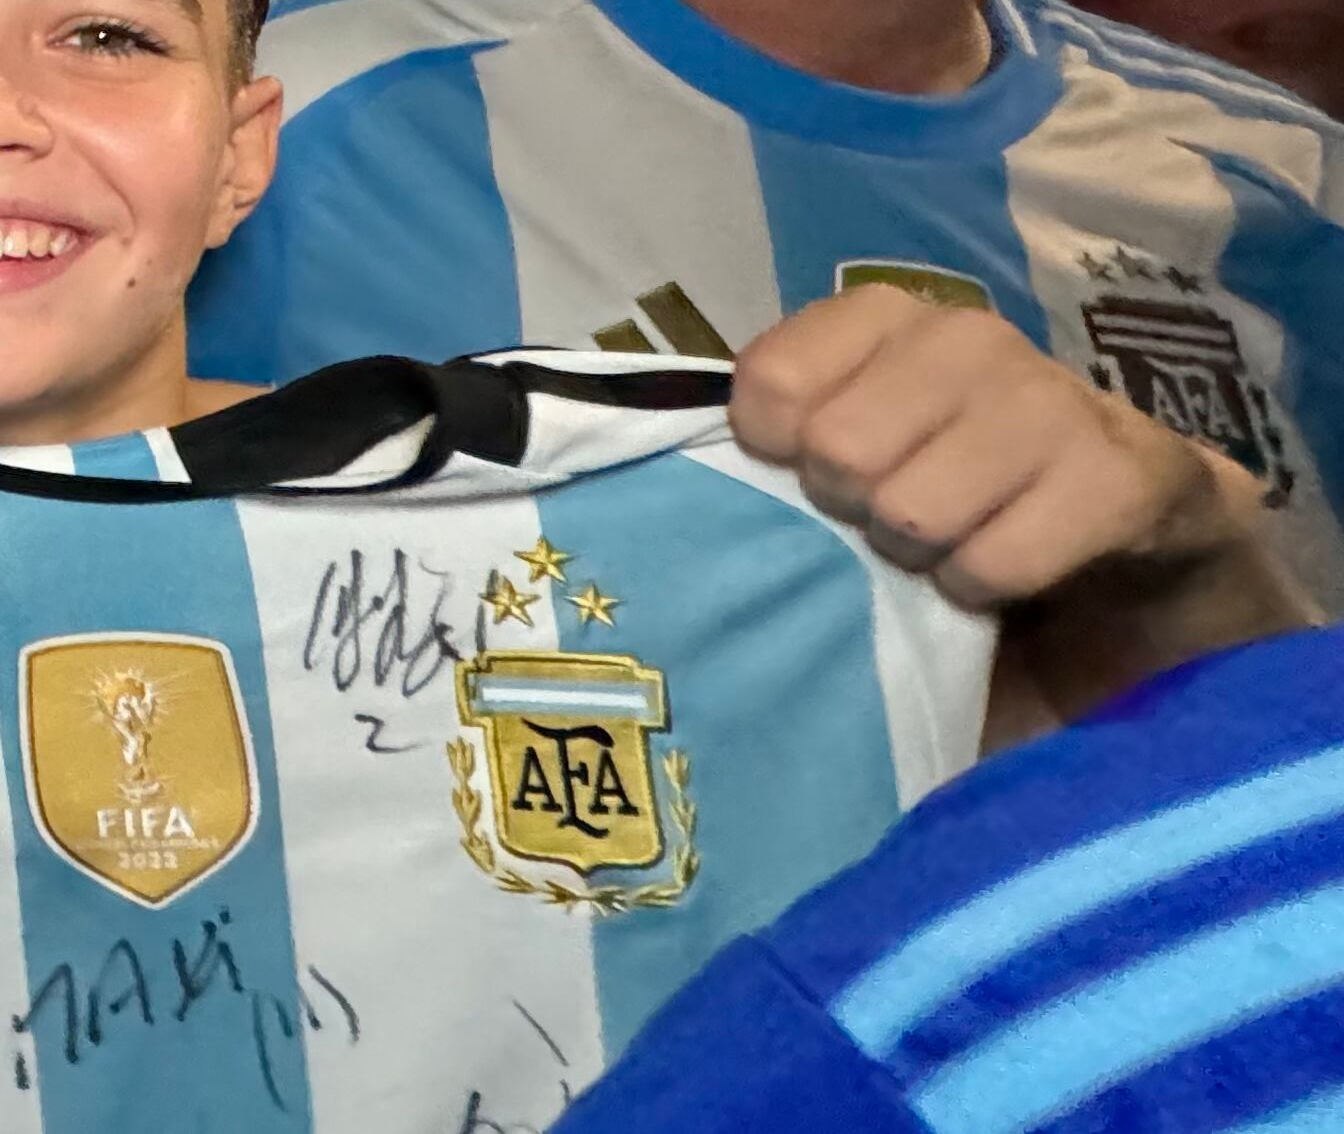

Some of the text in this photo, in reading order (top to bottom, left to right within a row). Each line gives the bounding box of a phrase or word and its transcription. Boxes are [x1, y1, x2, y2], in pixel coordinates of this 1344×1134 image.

[512, 718, 640, 840] AFA
[96, 806, 196, 839] FIFA
[117, 850, 179, 870] 2022
